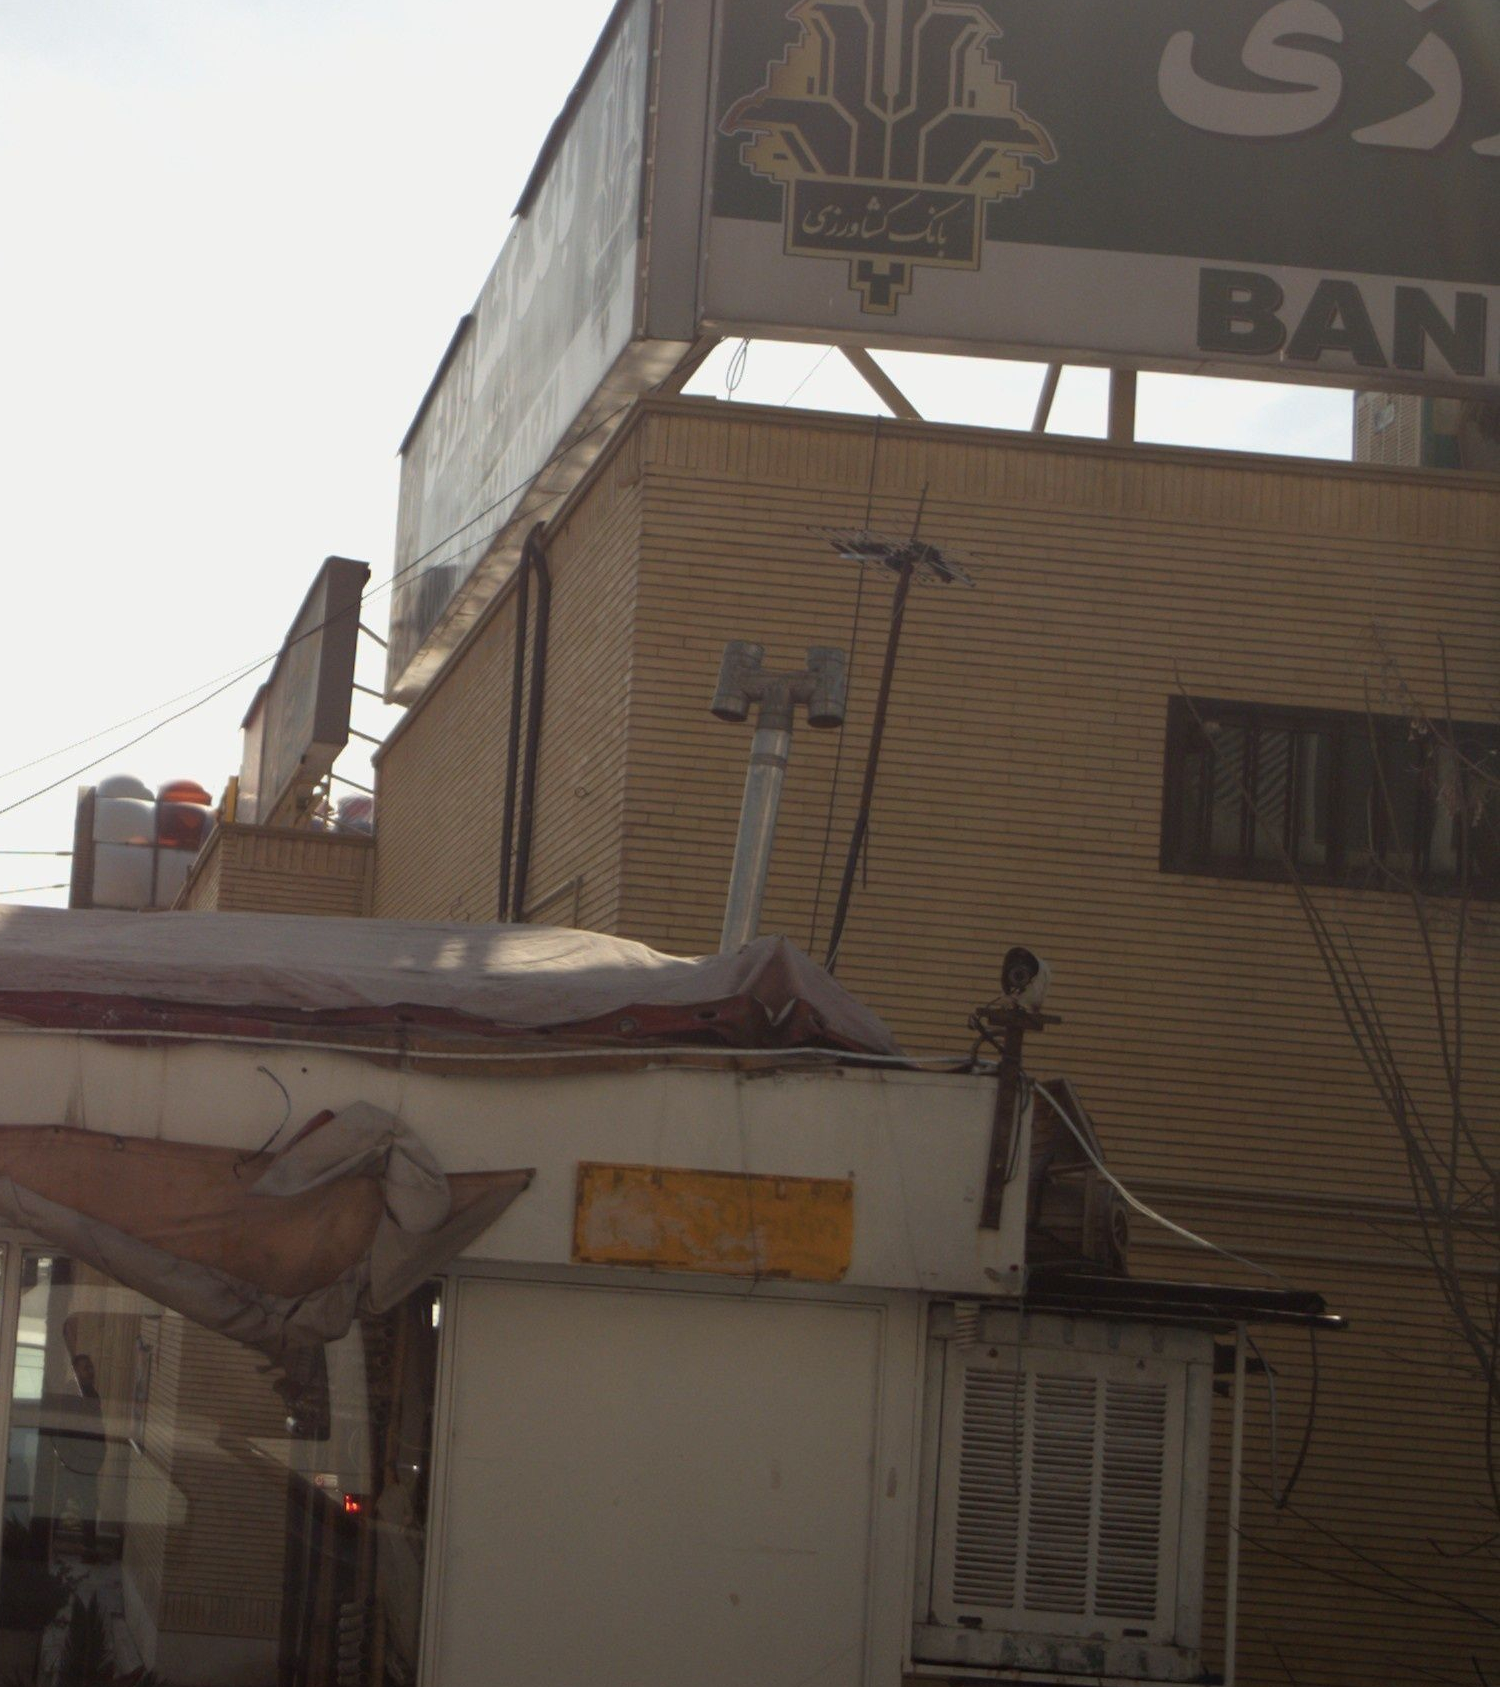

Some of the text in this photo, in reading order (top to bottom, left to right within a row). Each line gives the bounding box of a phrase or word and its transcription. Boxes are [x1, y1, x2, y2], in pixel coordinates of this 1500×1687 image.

[802, 191, 965, 258] بانک کشاورزی
[1197, 267, 1500, 377] BAN
